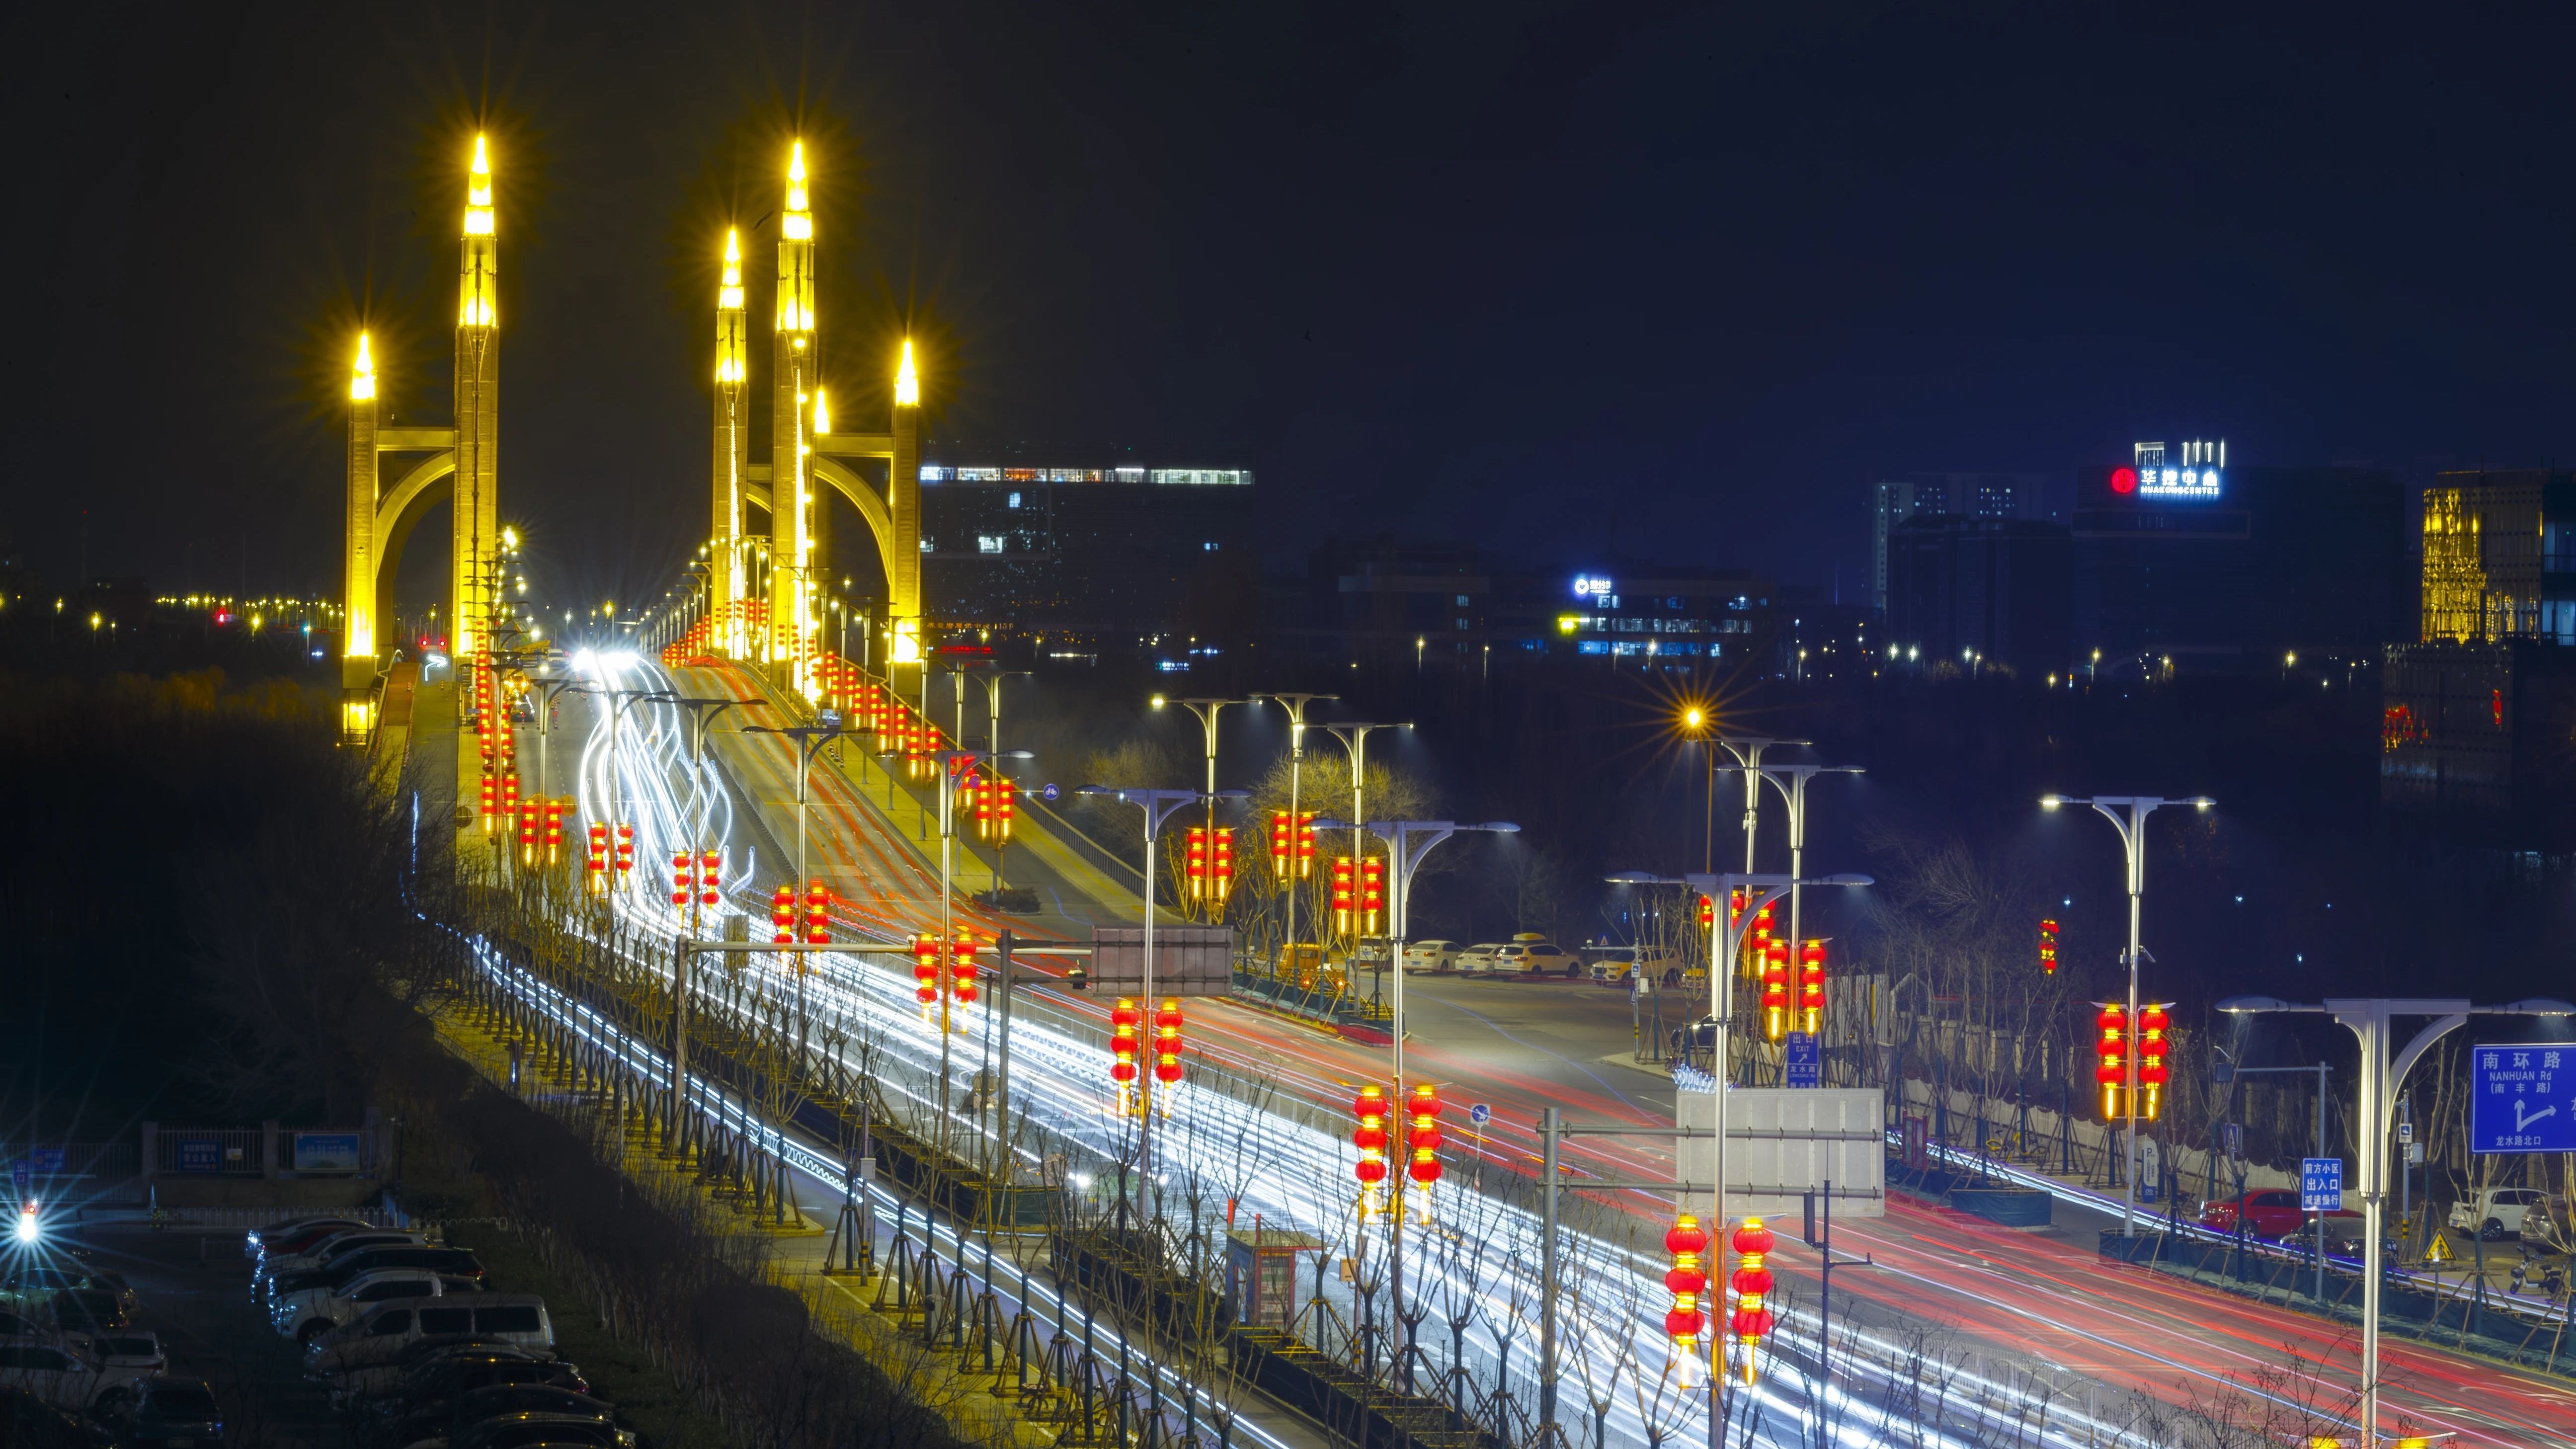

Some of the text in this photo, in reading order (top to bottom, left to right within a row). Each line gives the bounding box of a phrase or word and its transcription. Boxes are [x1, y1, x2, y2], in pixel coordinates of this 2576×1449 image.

[1793, 1034, 1813, 1044] 出口
[2483, 1051, 2561, 1069] 南环路
[2490, 1071, 2552, 1081] NANHUAN Rd
[2496, 1135, 2541, 1146] 龙水路北口
[2305, 1163, 2339, 1174] 前方小区
[2307, 1178, 2338, 1191] 出入口
[2305, 1195, 2339, 1206] 减速慢行
